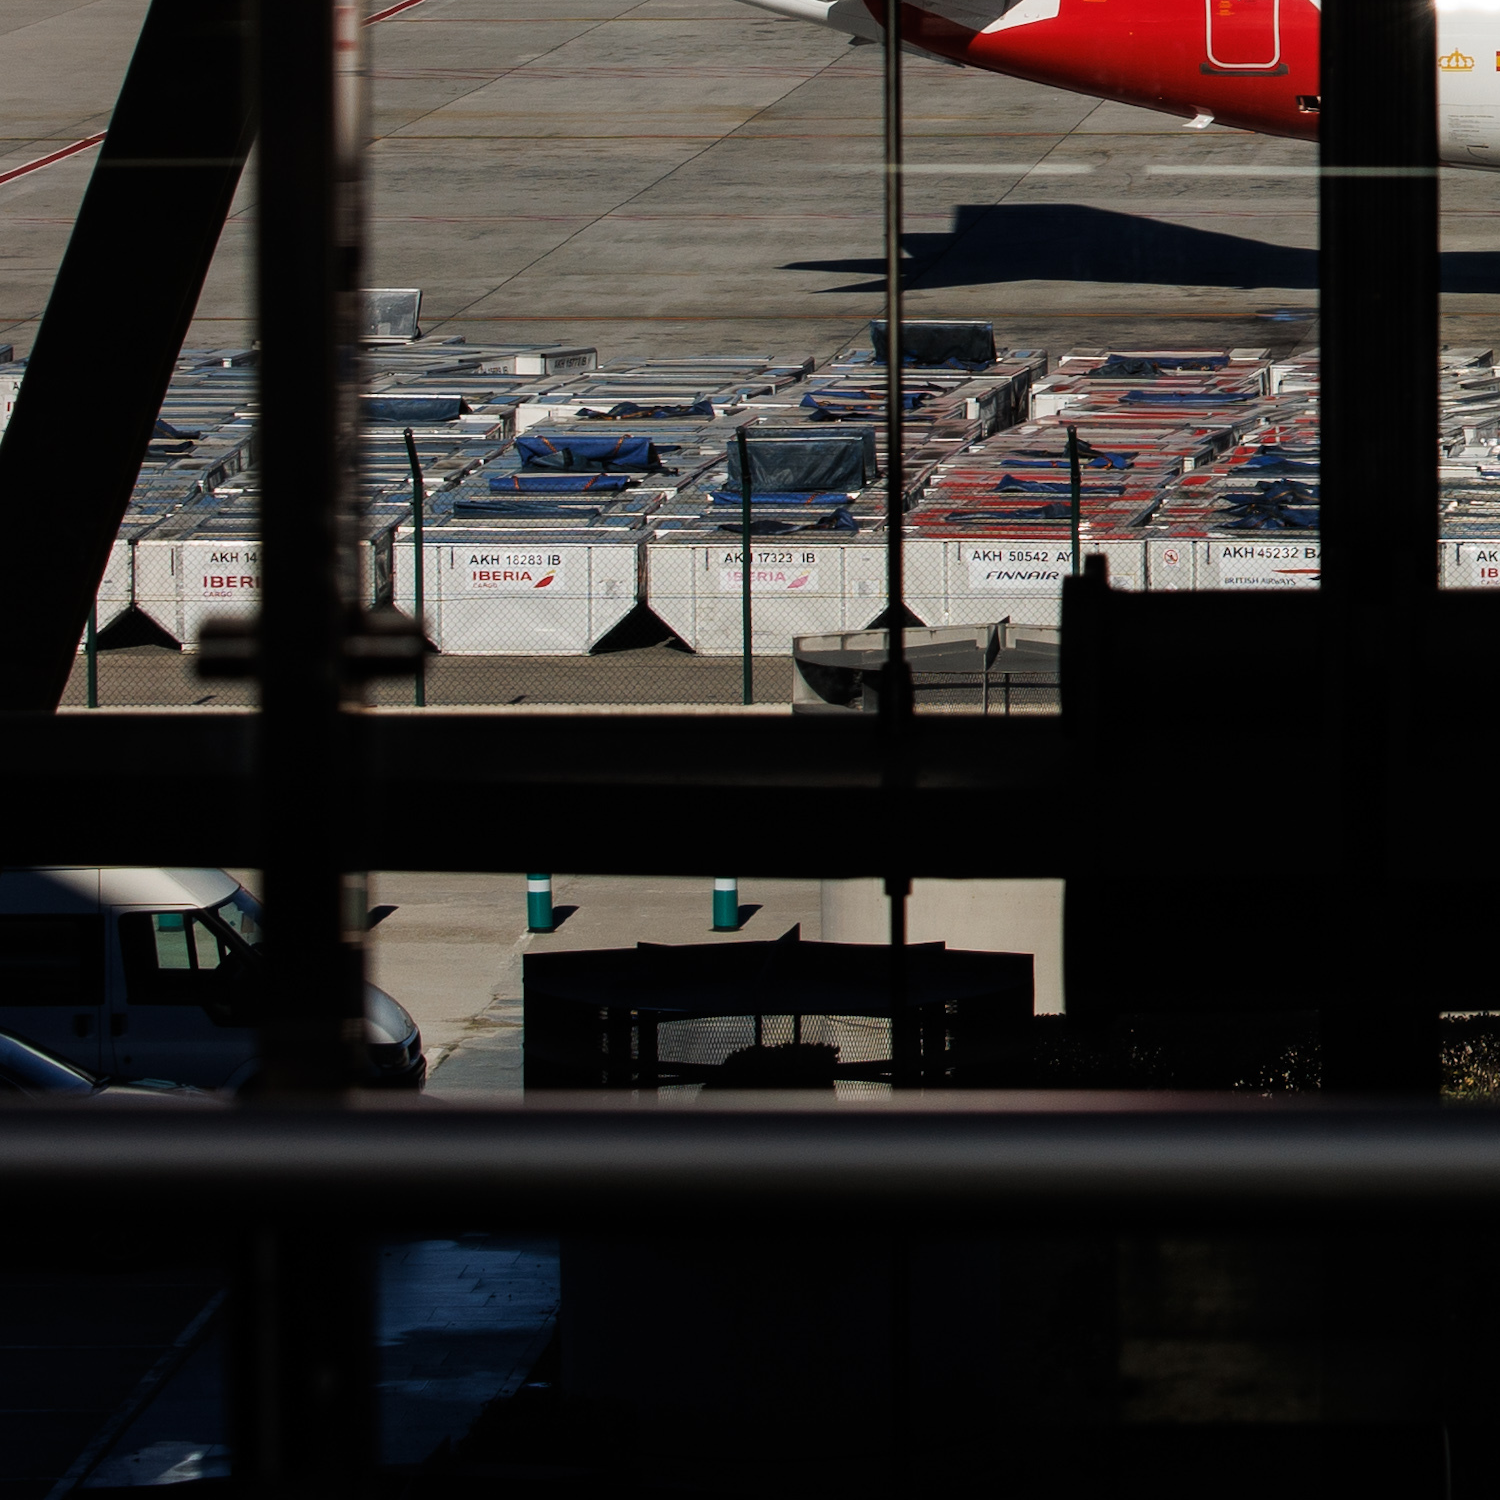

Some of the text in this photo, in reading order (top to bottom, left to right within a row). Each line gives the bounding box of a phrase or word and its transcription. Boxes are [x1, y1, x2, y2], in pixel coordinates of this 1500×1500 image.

[210, 552, 239, 563] AKH
[759, 552, 793, 563] 17323
[802, 552, 816, 563] IB
[972, 550, 1073, 562] AKH 50542 AY
[1222, 547, 1254, 559] AKH
[1257, 547, 1299, 559] 45232
[469, 554, 500, 565] AKH
[547, 554, 561, 566] IB
[472, 570, 532, 581] IBERIA
[986, 570, 1059, 580] FINNAIR
[203, 575, 262, 588] IBERI
[1224, 577, 1296, 586] BRITISH AIRWAYS
